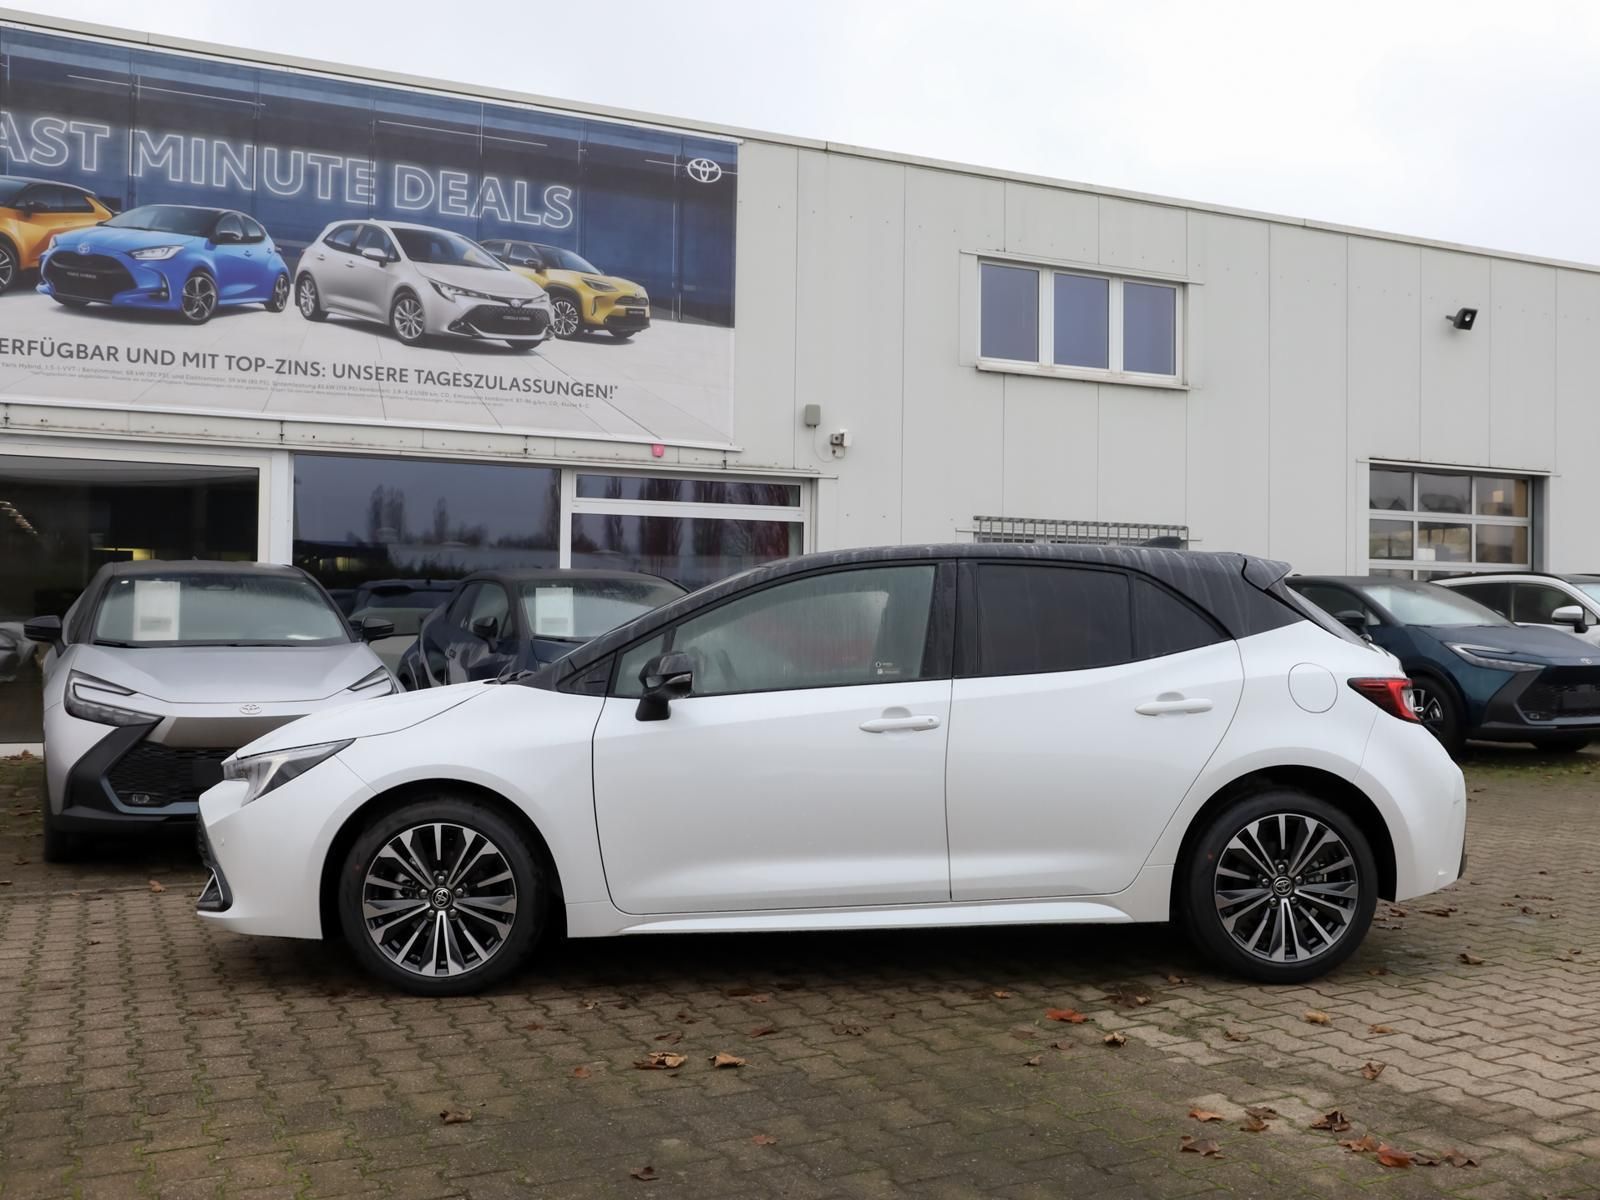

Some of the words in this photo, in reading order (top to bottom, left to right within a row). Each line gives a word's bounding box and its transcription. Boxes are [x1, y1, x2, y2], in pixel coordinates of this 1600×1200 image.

[128, 128, 374, 205] MINUTE
[394, 164, 574, 229] DEALS
[0, 336, 120, 363] ERFÜGBAR
[126, 347, 176, 366] UND
[182, 351, 220, 369] MIT
[224, 354, 326, 378] TOP-ZINS:
[332, 362, 409, 383] UNSERE
